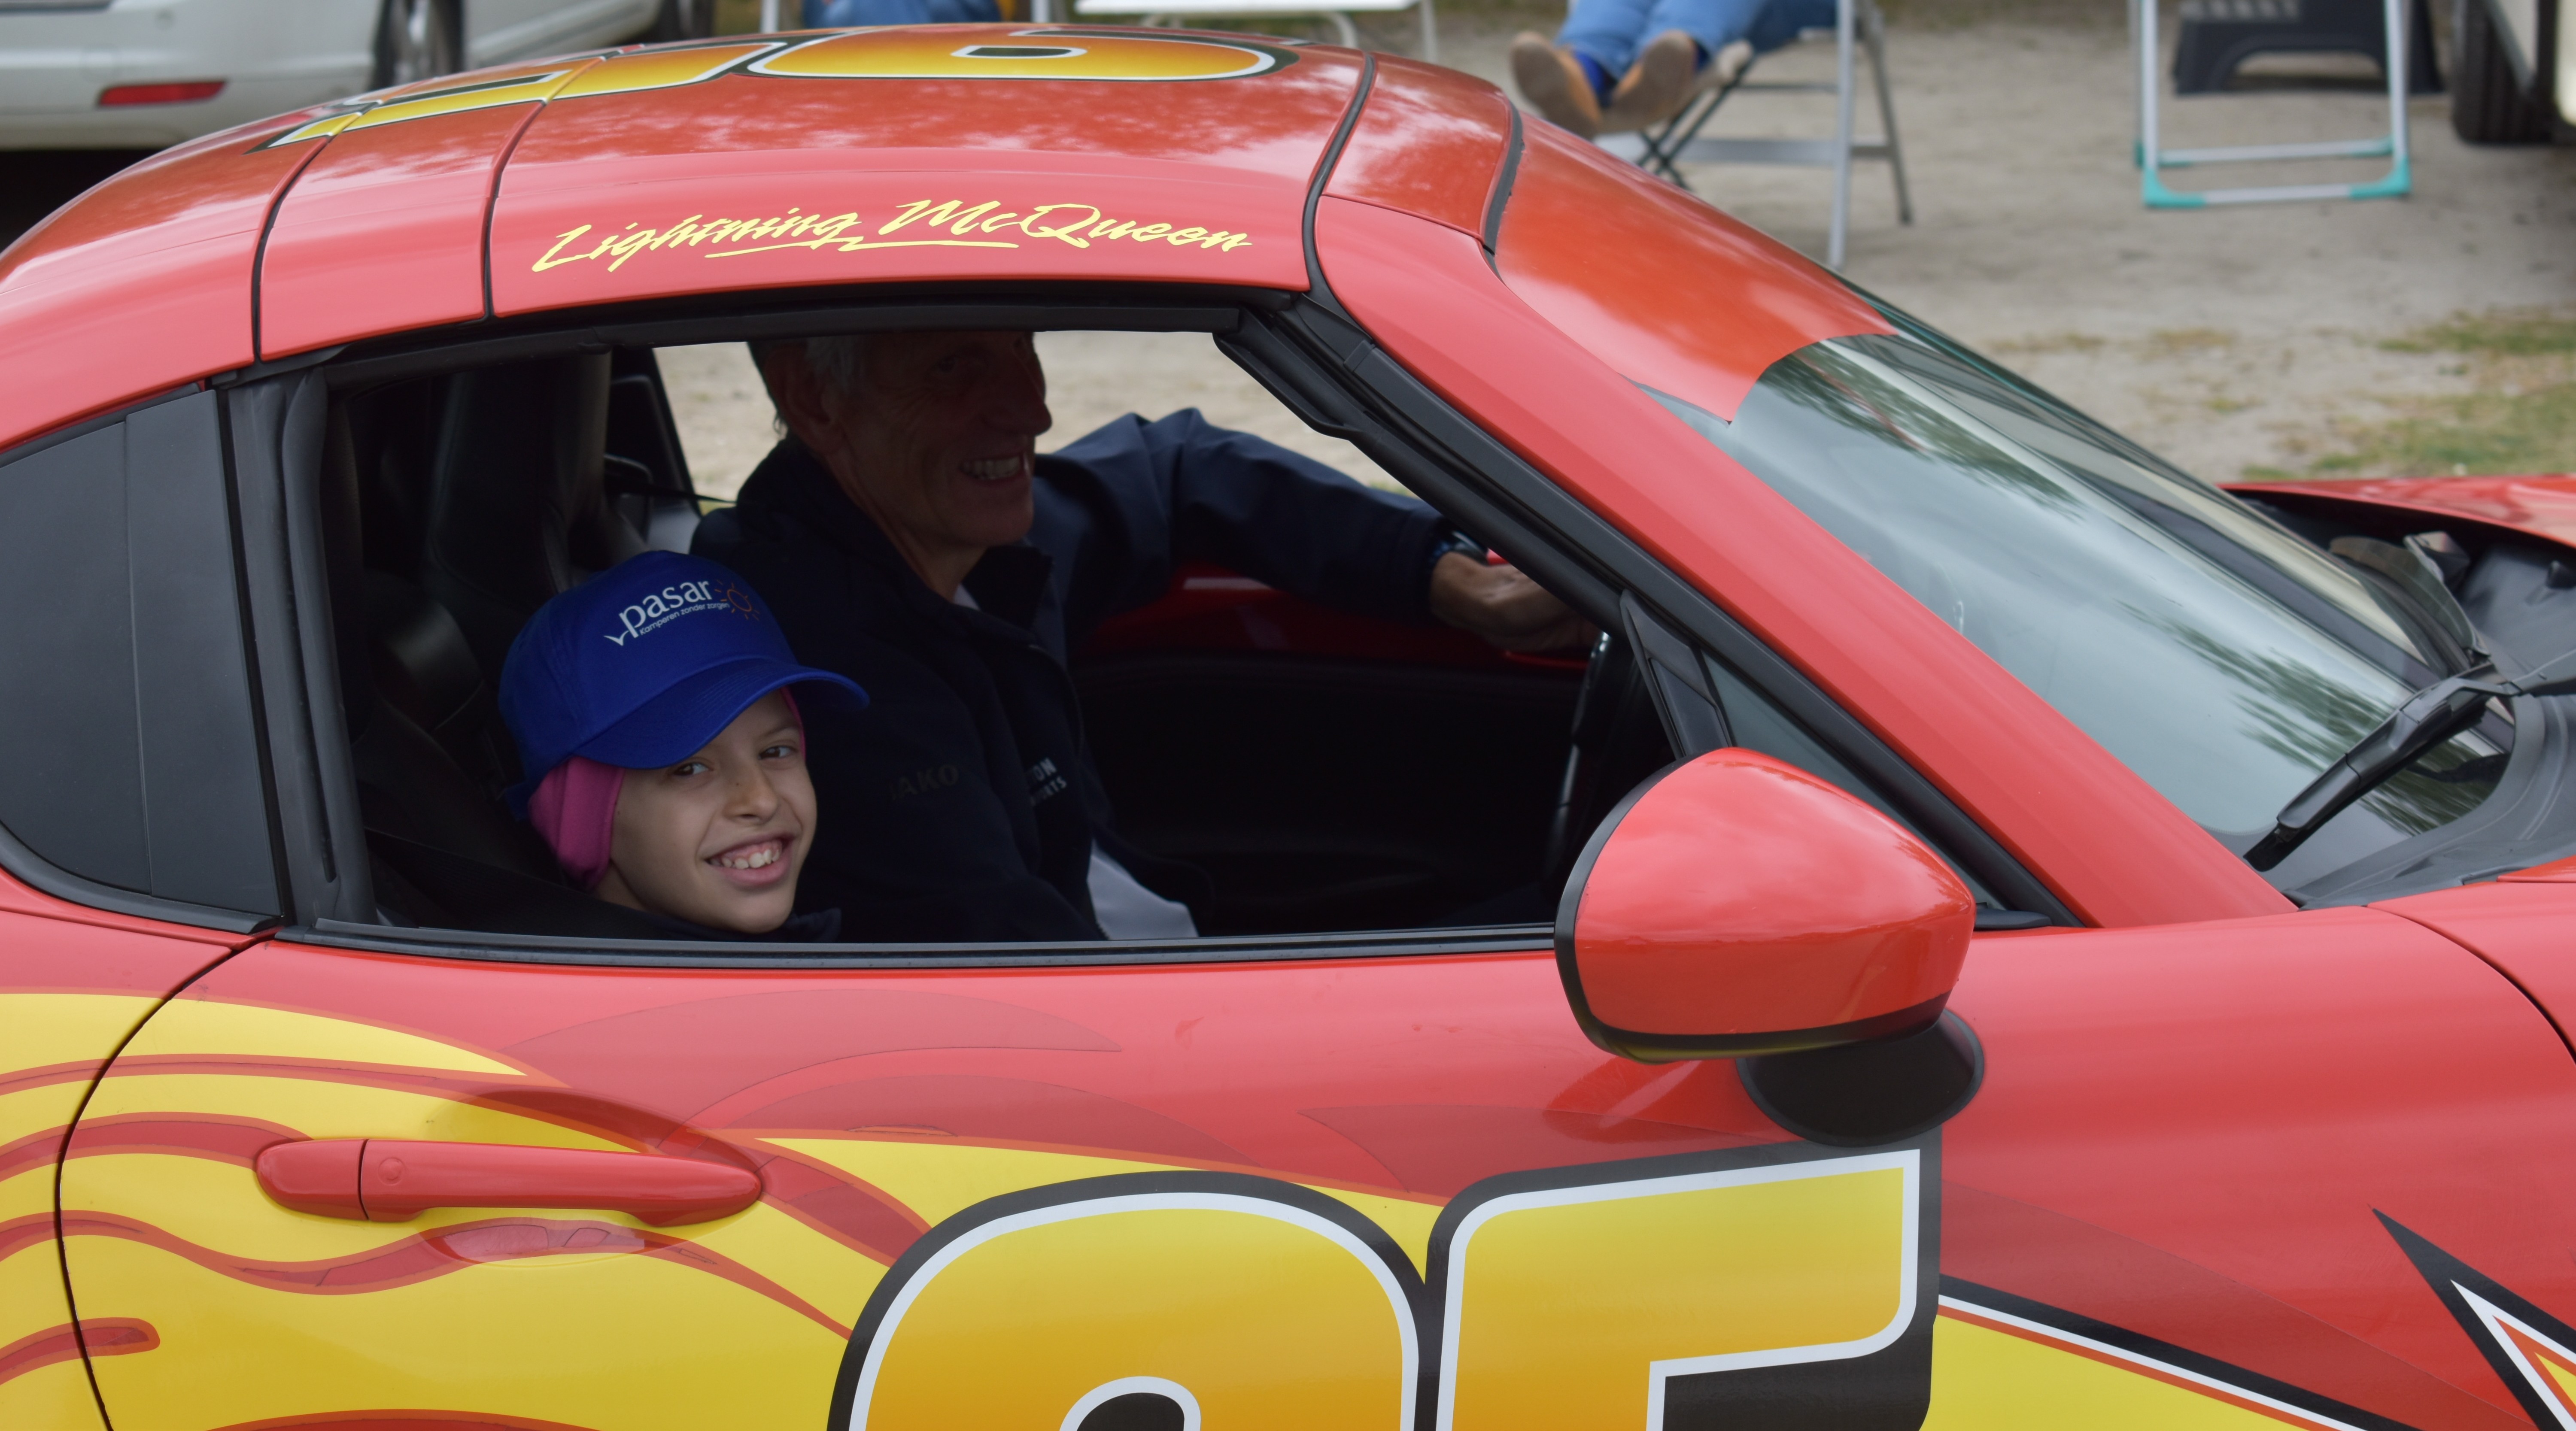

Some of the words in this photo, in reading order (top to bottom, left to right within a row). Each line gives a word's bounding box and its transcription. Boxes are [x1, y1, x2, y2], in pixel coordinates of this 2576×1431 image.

[532, 208, 864, 272] Lightning
[878, 200, 1253, 252] McQueen
[619, 580, 712, 638] pasar
[639, 611, 680, 635] Kamperen
[680, 603, 706, 615] zonder
[1027, 757, 1057, 782] ON
